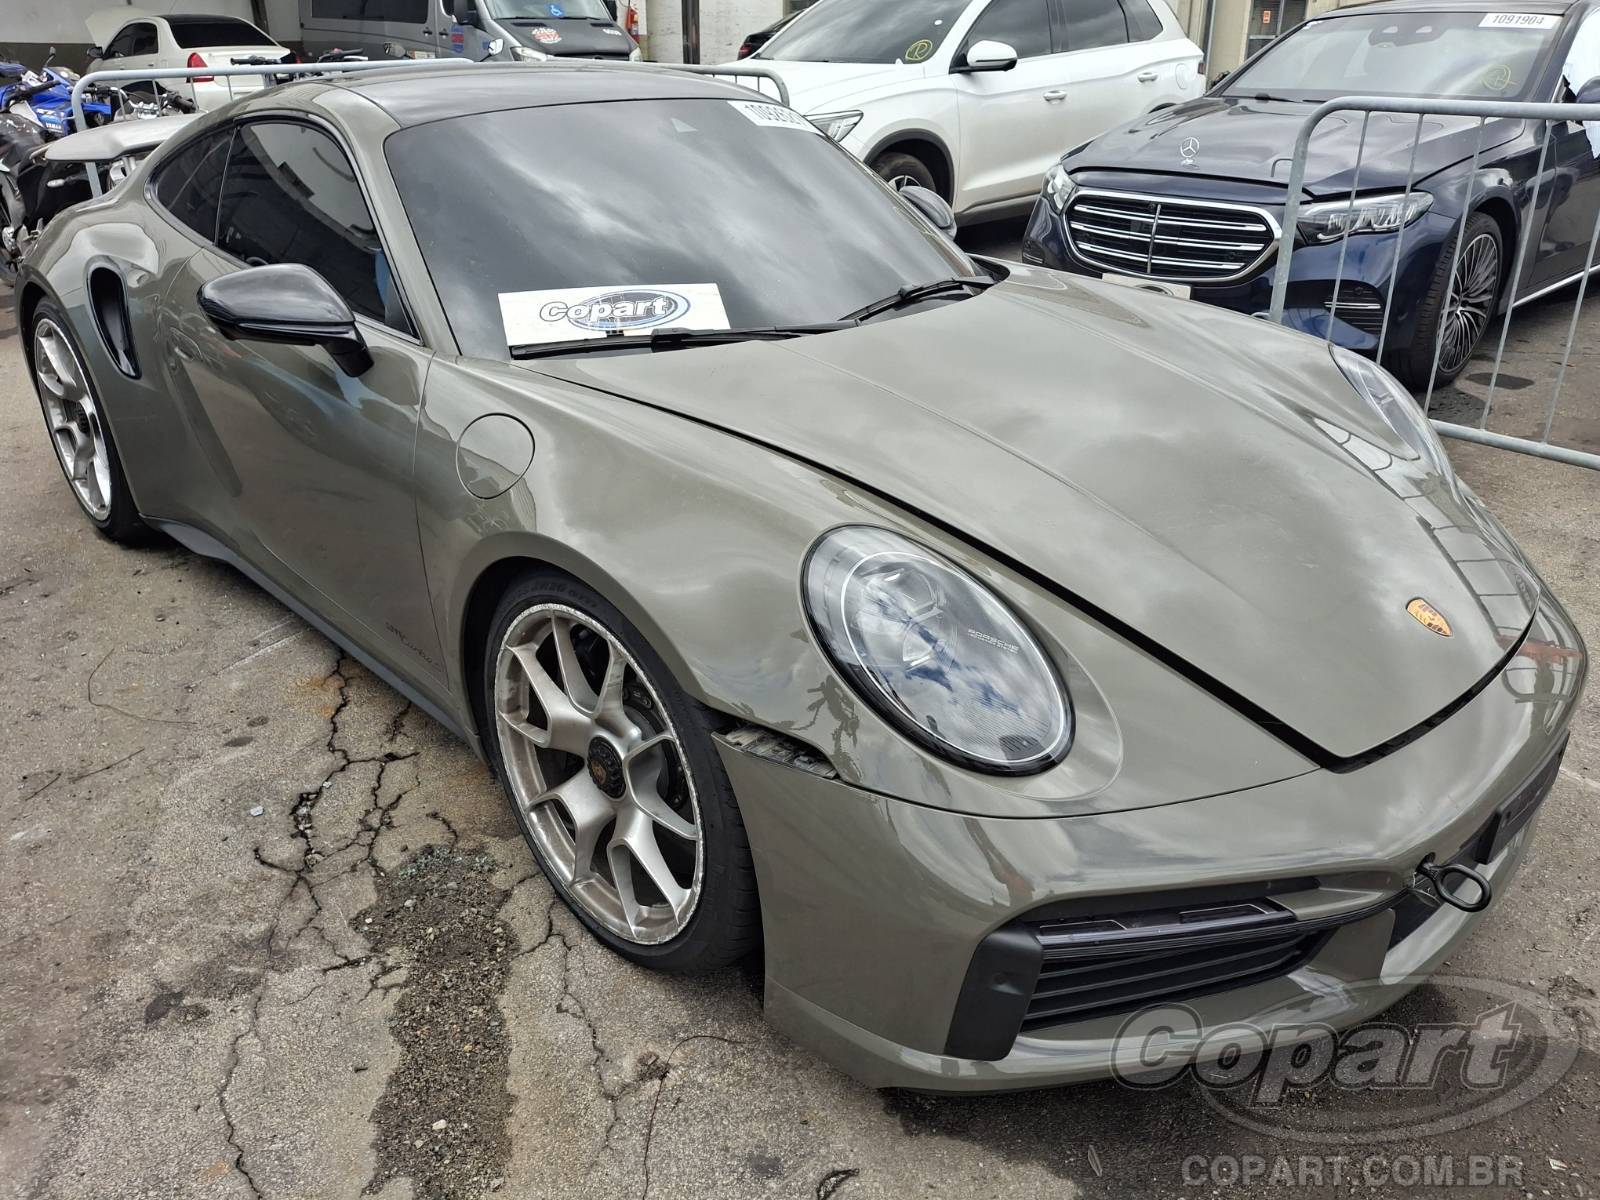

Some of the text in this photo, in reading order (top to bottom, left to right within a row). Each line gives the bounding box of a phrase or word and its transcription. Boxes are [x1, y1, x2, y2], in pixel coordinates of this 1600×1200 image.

[1492, 14, 1545, 25] 1091904
[539, 295, 669, 323] Copart
[967, 628, 1019, 651] PORSCHE
